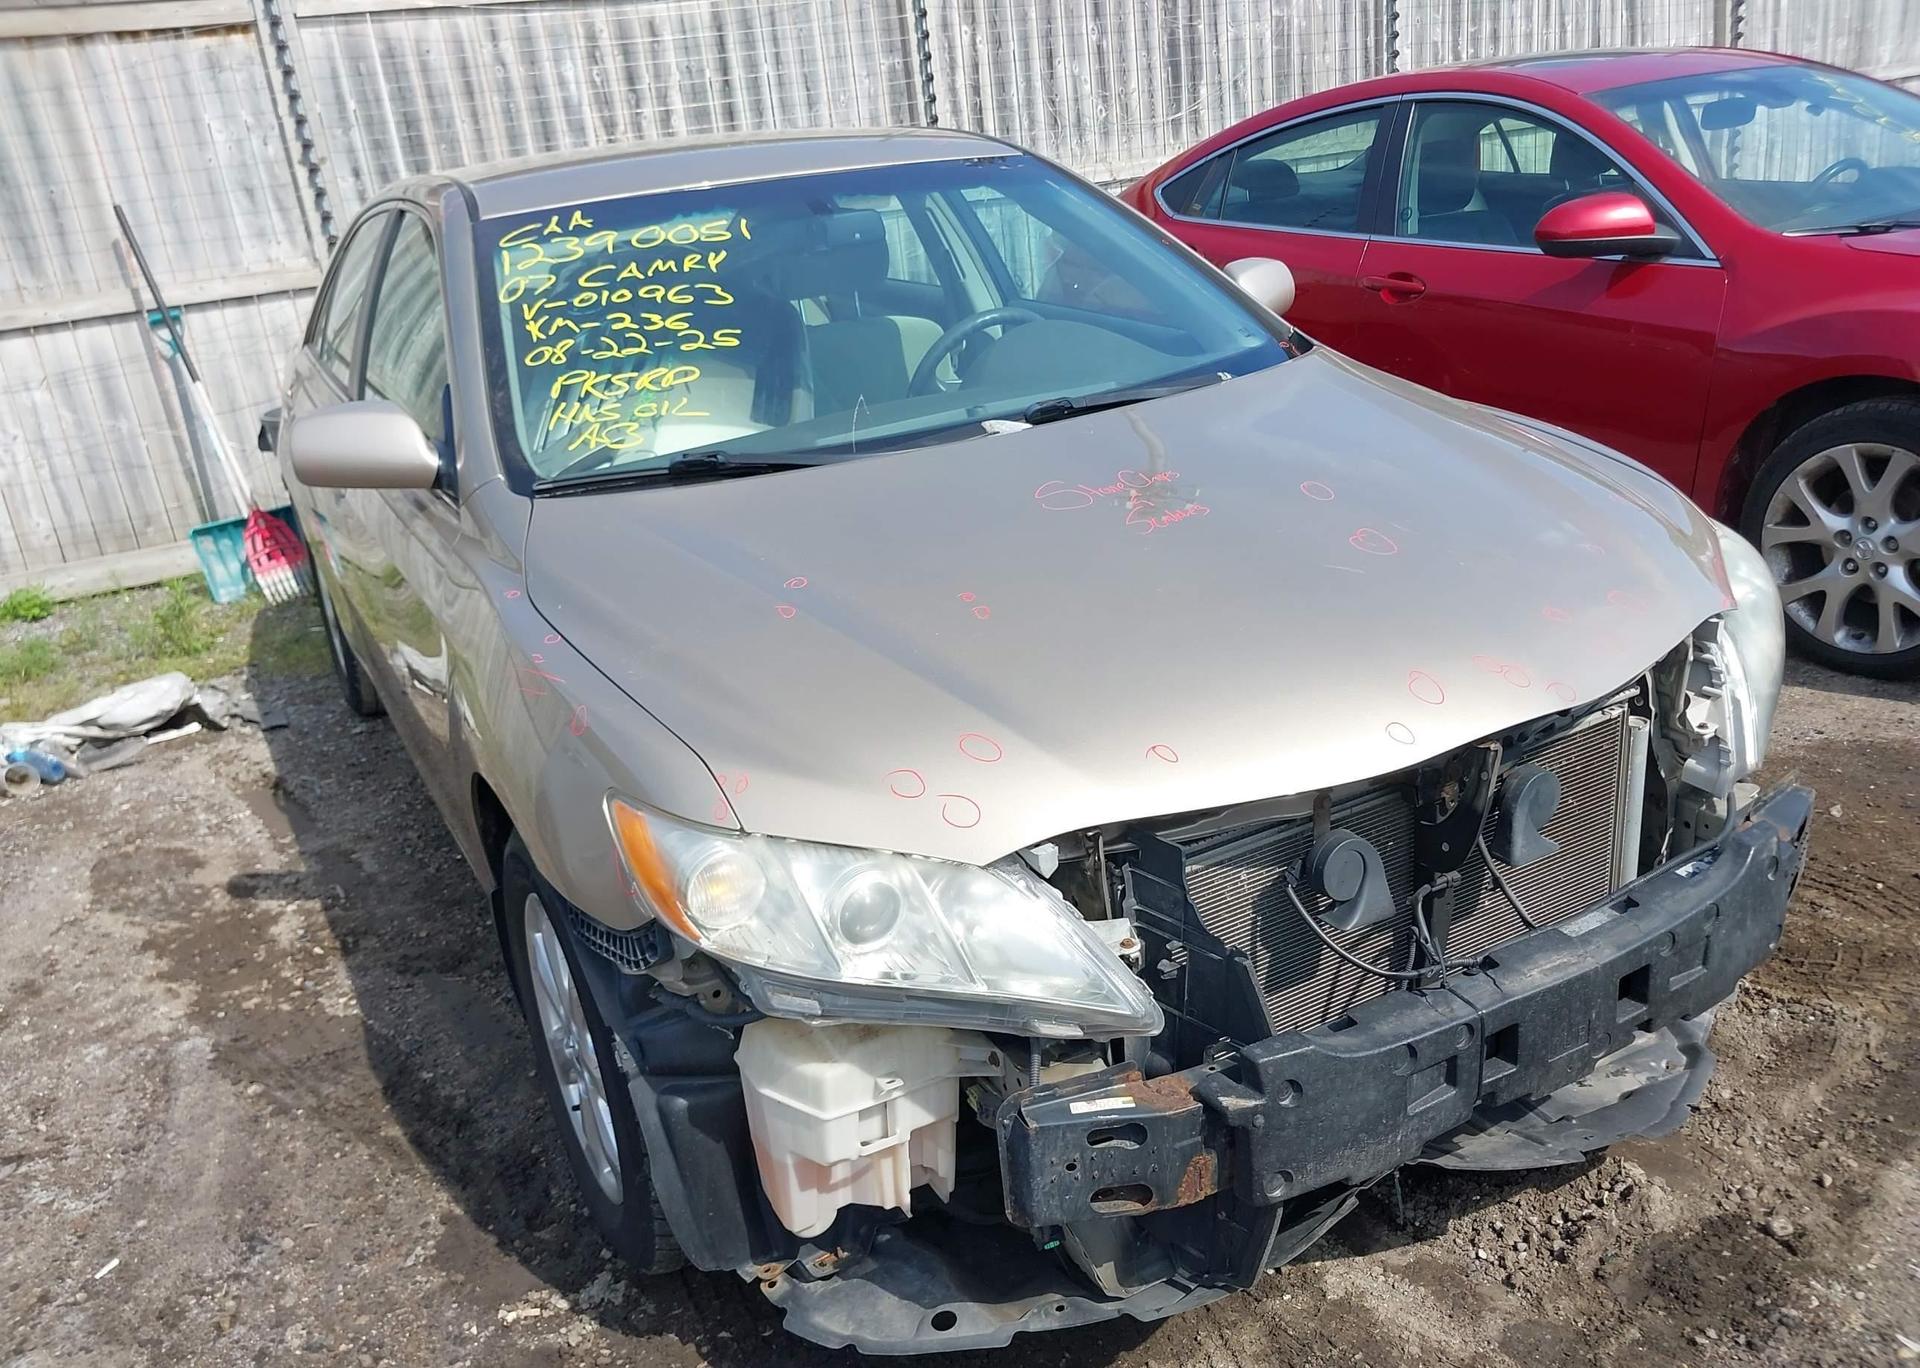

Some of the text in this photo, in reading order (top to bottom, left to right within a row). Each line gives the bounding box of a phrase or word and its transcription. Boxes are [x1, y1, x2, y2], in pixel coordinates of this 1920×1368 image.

[499, 250, 728, 304] 07 CAMRY
[634, 397, 711, 418] OIL
